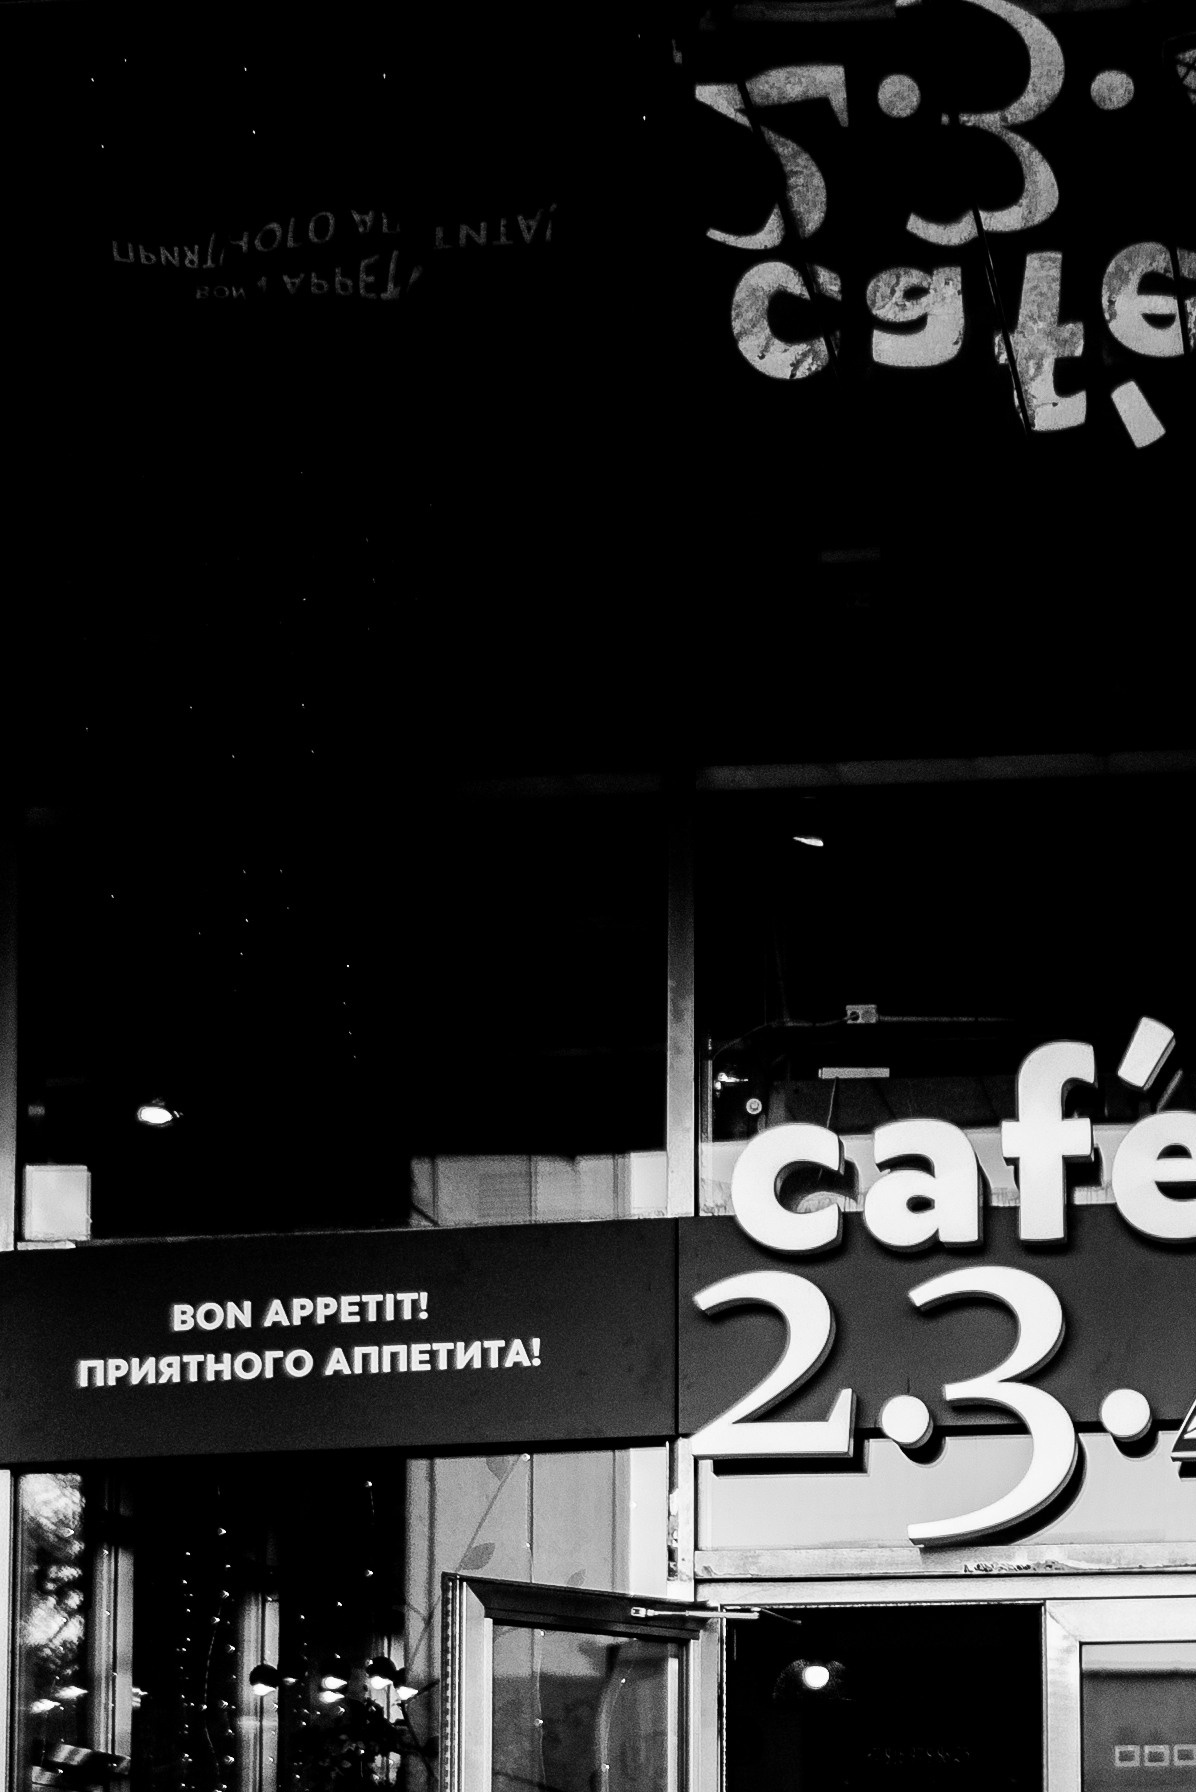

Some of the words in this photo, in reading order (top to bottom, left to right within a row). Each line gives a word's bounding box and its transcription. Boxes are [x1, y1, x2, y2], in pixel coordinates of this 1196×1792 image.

[171, 1300, 252, 1332] BON
[263, 1291, 429, 1328] APPETIT!
[76, 1348, 314, 1388] ПРИЯТНОГО
[324, 1337, 542, 1376] АППЕТИТА!
[690, 1266, 1152, 1547] 2.3.
